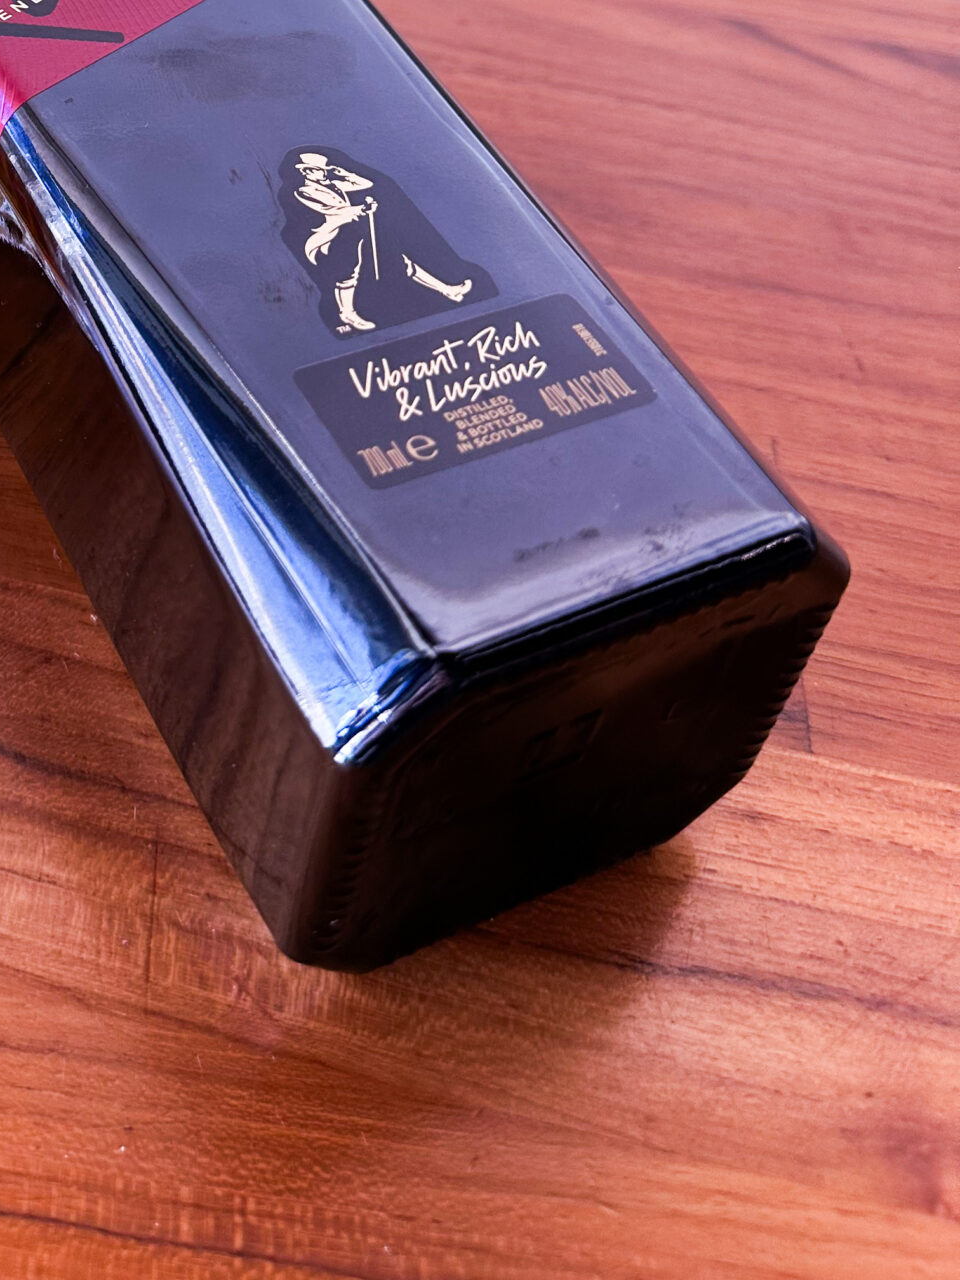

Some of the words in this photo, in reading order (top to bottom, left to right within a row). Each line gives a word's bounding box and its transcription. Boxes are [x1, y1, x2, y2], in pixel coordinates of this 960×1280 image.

[467, 321, 541, 363] Rich
[395, 387, 423, 421] &
[426, 356, 547, 412] Luscious
[455, 404, 516, 430] BLENDED
[456, 431, 468, 441] &
[467, 412, 527, 438] BOTTLED
[456, 441, 473, 454] IN
[473, 418, 544, 448] SCOTLAND
